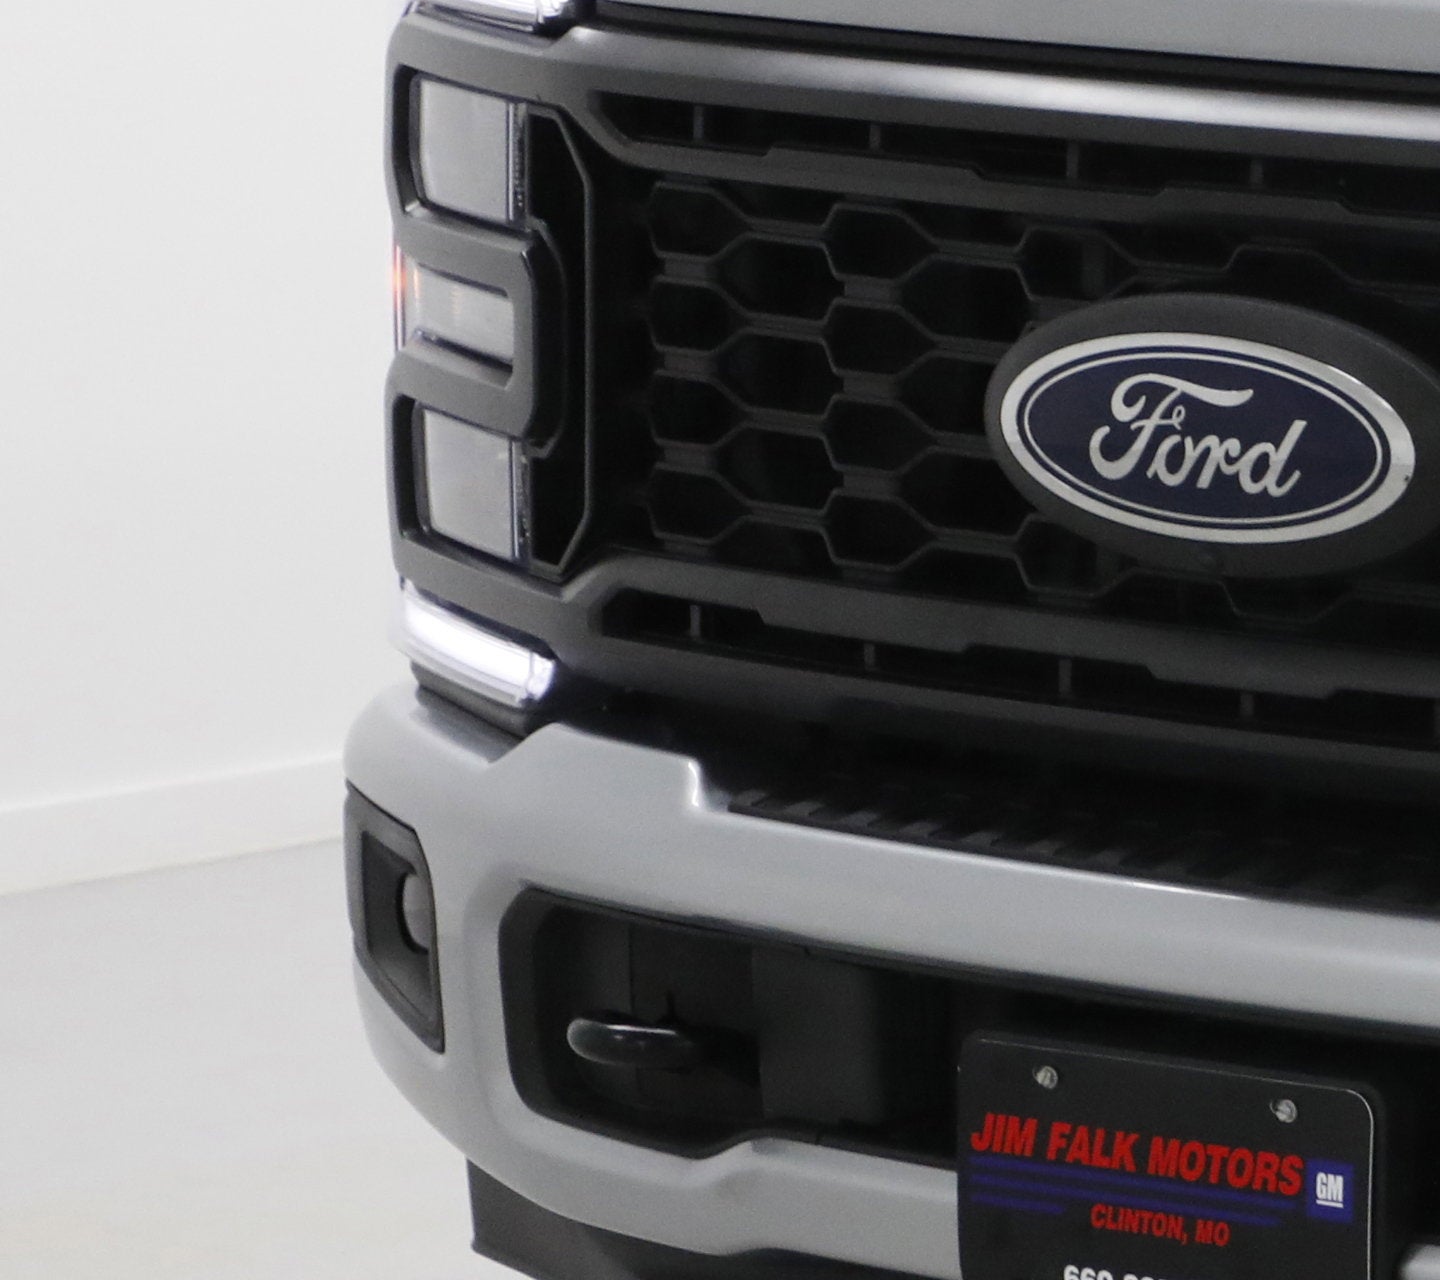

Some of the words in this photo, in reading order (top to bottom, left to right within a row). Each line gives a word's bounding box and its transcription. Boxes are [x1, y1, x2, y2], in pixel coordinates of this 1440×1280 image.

[1088, 372, 1308, 498] Ford
[970, 1112, 1038, 1156] JIM
[1046, 1121, 1139, 1173] FALK
[1148, 1136, 1305, 1197] MOTORS
[1315, 1171, 1344, 1203] GM
[1090, 1203, 1188, 1244] CLINTON,
[1194, 1219, 1231, 1247] MO
